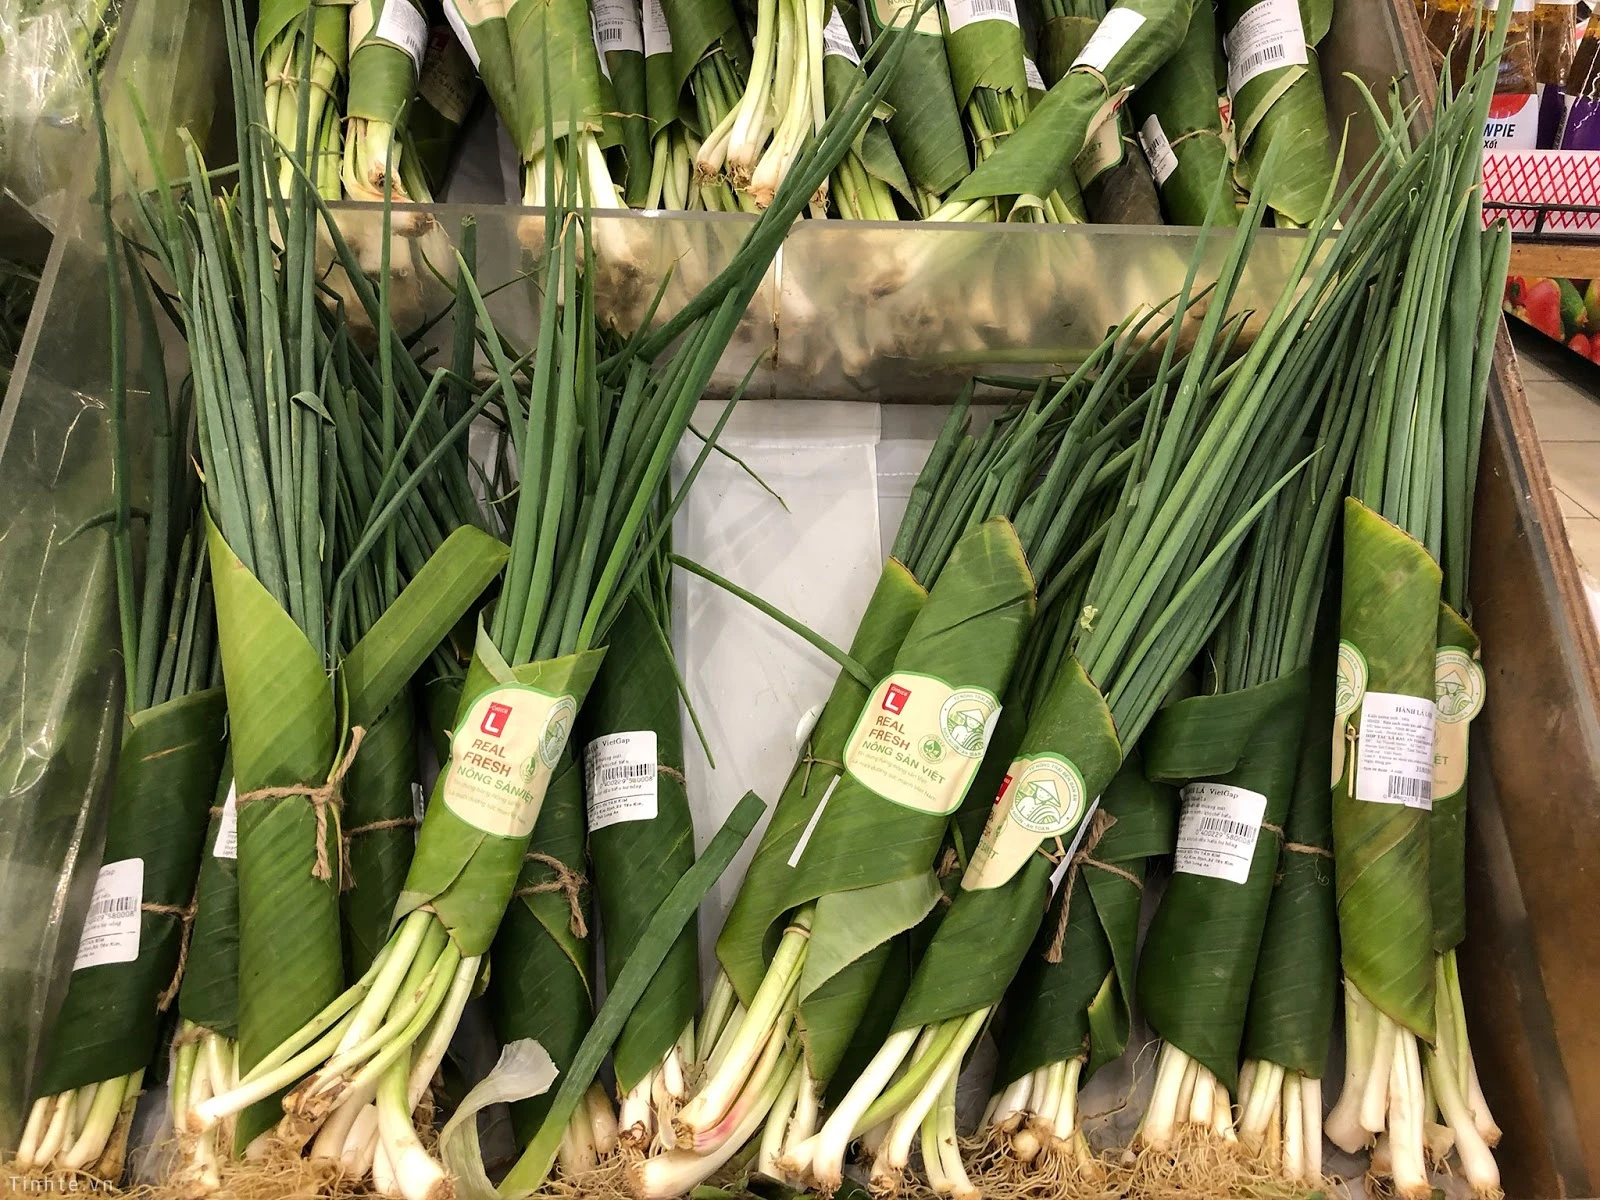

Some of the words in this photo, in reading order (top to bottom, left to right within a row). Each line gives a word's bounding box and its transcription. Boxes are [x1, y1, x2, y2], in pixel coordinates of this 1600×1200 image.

[1483, 123, 1516, 138] NPIE
[885, 692, 899, 712] L
[484, 711, 500, 734] L
[876, 715, 905, 735] REAL
[471, 738, 506, 759] REAL
[602, 737, 630, 747] VietGap
[868, 728, 911, 751] FRESH
[463, 753, 512, 777] FRESH
[862, 740, 893, 756] NÔNG
[895, 752, 919, 769] SẢN
[922, 765, 946, 785] VIỆT
[1434, 753, 1448, 766] ỆT
[457, 765, 492, 784] NÔNG
[1209, 788, 1239, 799] VietGap
